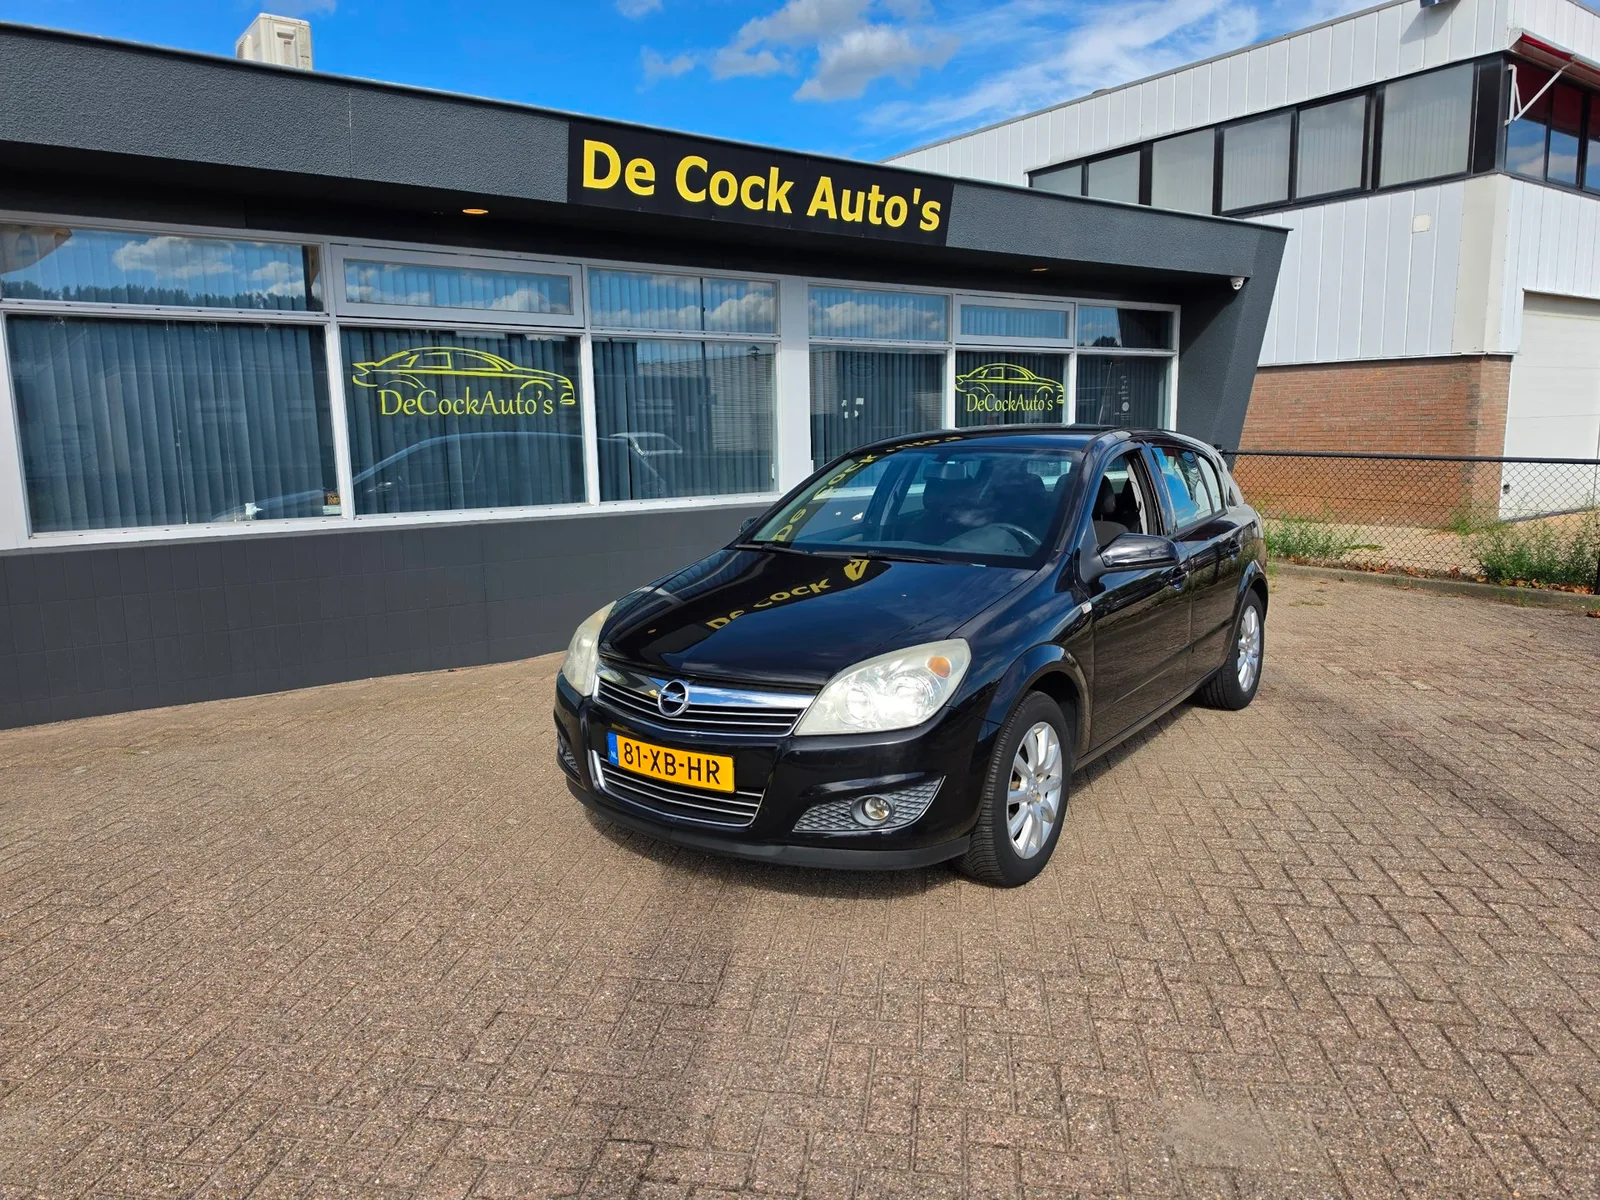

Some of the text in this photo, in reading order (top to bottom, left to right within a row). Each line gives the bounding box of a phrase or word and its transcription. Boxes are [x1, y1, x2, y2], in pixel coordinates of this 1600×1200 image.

[582, 138, 942, 232] De Cock Auto's
[624, 742, 721, 785] 81-XB-HR
